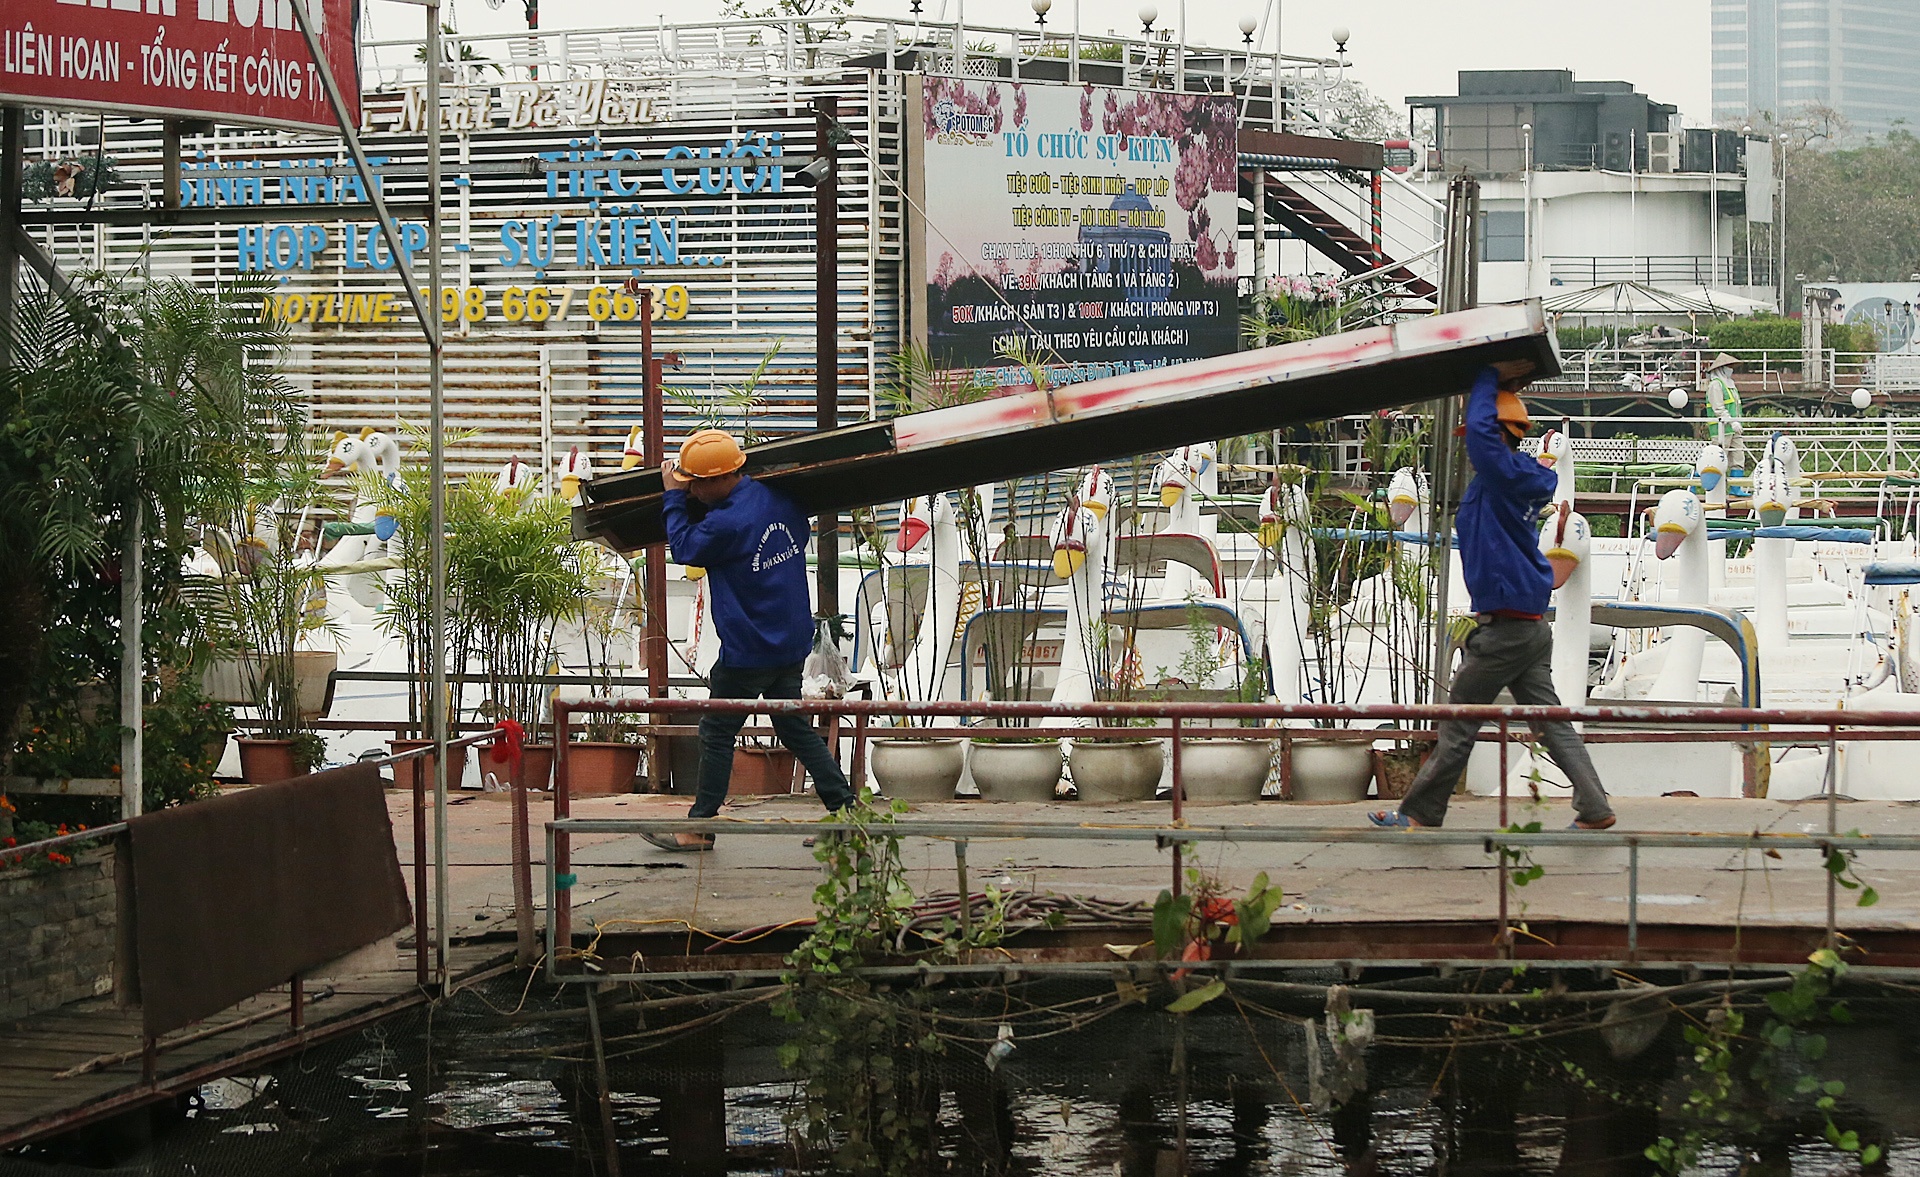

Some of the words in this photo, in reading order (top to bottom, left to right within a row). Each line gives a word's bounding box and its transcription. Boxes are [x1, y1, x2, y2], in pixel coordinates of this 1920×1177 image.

[5, 21, 53, 76] LIÊN
[60, 36, 119, 82] HOAN
[141, 25, 197, 90] TỔNG
[203, 37, 237, 93] KẾT
[242, 47, 302, 100] CÔNG
[954, 113, 995, 133] POTOMAC
[1003, 118, 1029, 157] TỔ
[1037, 127, 1089, 160] CHỨC
[1096, 132, 1121, 167] SỰ
[1127, 130, 1174, 169] KIỆN
[1007, 171, 1028, 197] TIỆC
[1060, 172, 1080, 198] TIỆC
[1081, 175, 1103, 195] SINH
[1104, 174, 1126, 199] NHẬT
[1153, 175, 1169, 197] LỚP
[1012, 204, 1033, 230] TIỆC
[1035, 204, 1059, 227] CÔNG
[1060, 207, 1072, 226] TY
[1080, 205, 1096, 230] HỘI
[1097, 208, 1118, 232] NGHỊ
[1128, 207, 1143, 231] HỘI
[1144, 206, 1165, 228] THẢO
[237, 224, 328, 284] HỌP
[500, 213, 562, 280] SỰ
[982, 243, 1012, 265] CHẠY
[1073, 239, 1095, 258] THỨ
[1108, 239, 1129, 258] THỨ
[1130, 244, 1136, 258] 7
[1148, 238, 1168, 258] CHỦ
[1085, 266, 1113, 288] TẦNG
[1115, 273, 1121, 288] 1
[1123, 271, 1138, 288] VÀ
[1139, 266, 1166, 288] TẦNG
[502, 286, 576, 323] 667
[1079, 302, 1104, 319] 100K
[1109, 297, 1144, 318] KHÁCH
[1151, 298, 1185, 317] PHÒNG
[1186, 300, 1201, 316] VIP
[1030, 329, 1052, 350] TÀU
[1053, 332, 1081, 349] THEO
[1082, 327, 1103, 348] YÊU
[1104, 325, 1126, 347] CẦU
[1128, 323, 1149, 346] CỦA
[1150, 326, 1184, 345] KHÁCH
